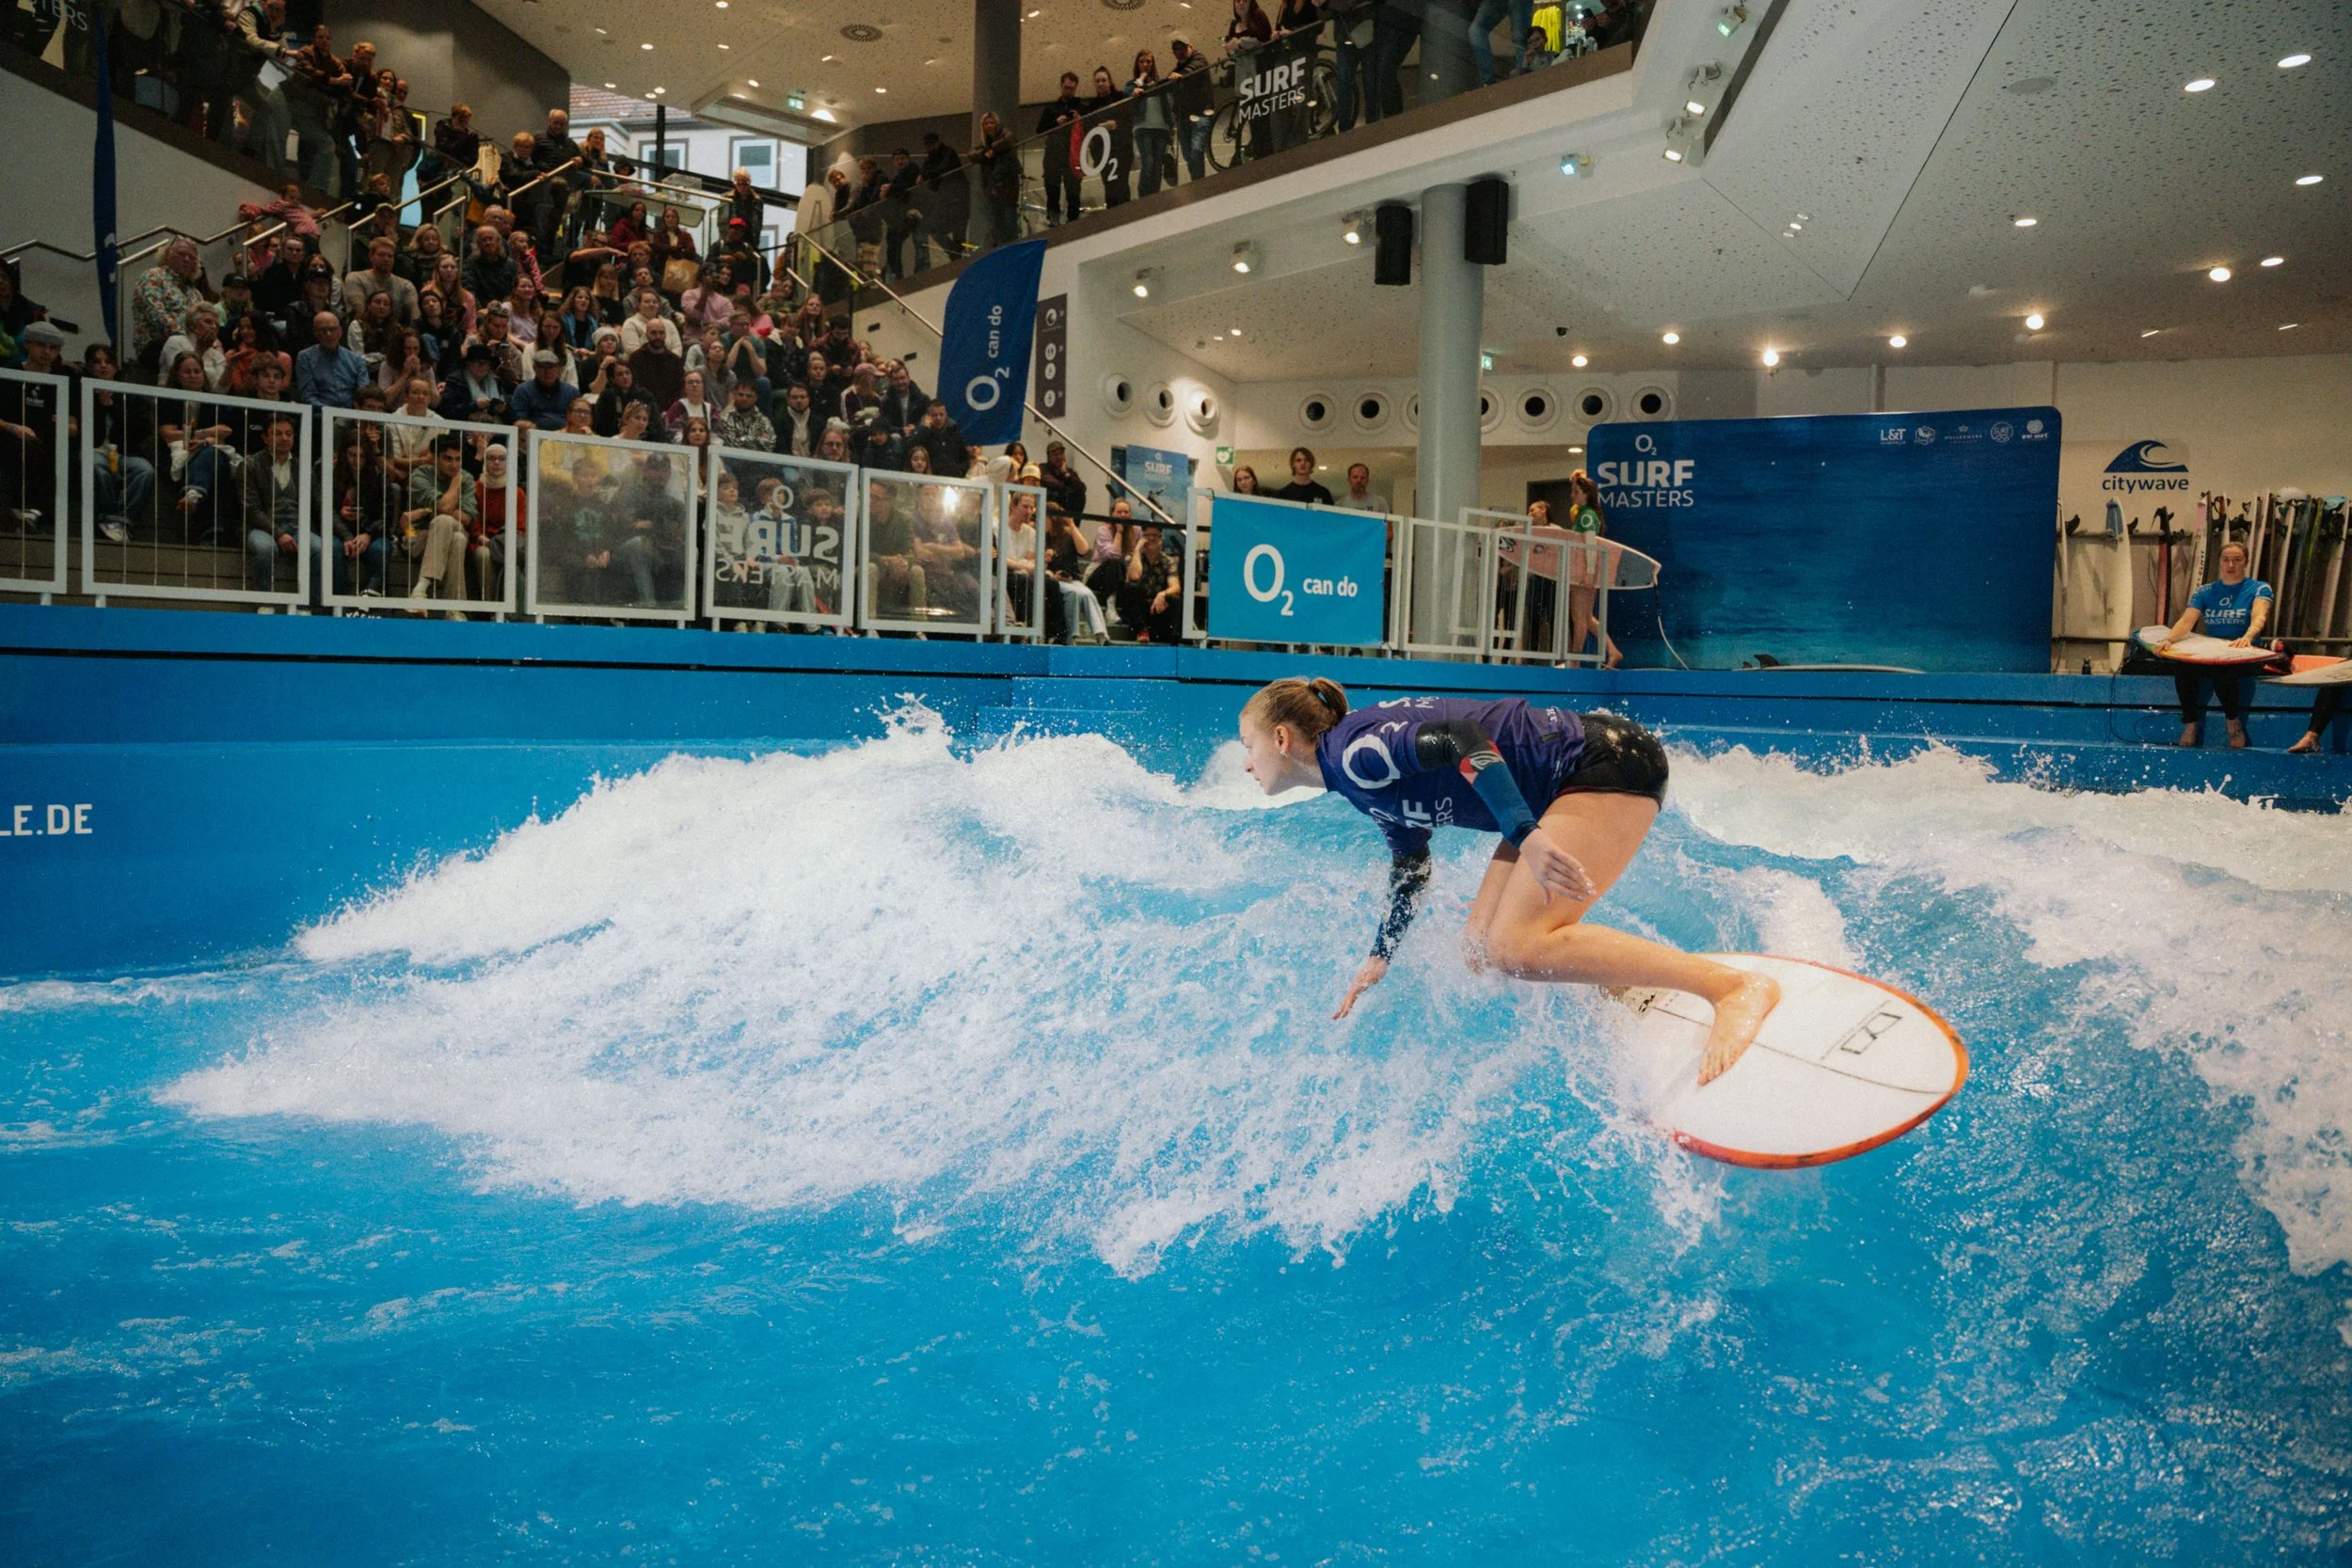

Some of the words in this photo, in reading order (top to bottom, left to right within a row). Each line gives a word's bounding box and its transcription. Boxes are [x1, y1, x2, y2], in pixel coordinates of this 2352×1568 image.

[1239, 56, 1307, 106] SURF
[1239, 86, 1306, 124] MASTERS
[1080, 126, 1119, 182] O2
[987, 305, 1002, 326] do
[988, 329, 1000, 358] can
[1635, 434, 1658, 456] O2
[1880, 428, 1907, 441] L&T
[1144, 461, 1172, 475] SURF
[1597, 459, 1695, 489] SURF
[2102, 475, 2190, 494] citywave
[1597, 489, 1694, 508] MASTERS
[1244, 544, 1295, 616] O2
[1302, 578, 1334, 595] can
[1337, 575, 1358, 597] do
[2204, 609, 2247, 618] SURF
